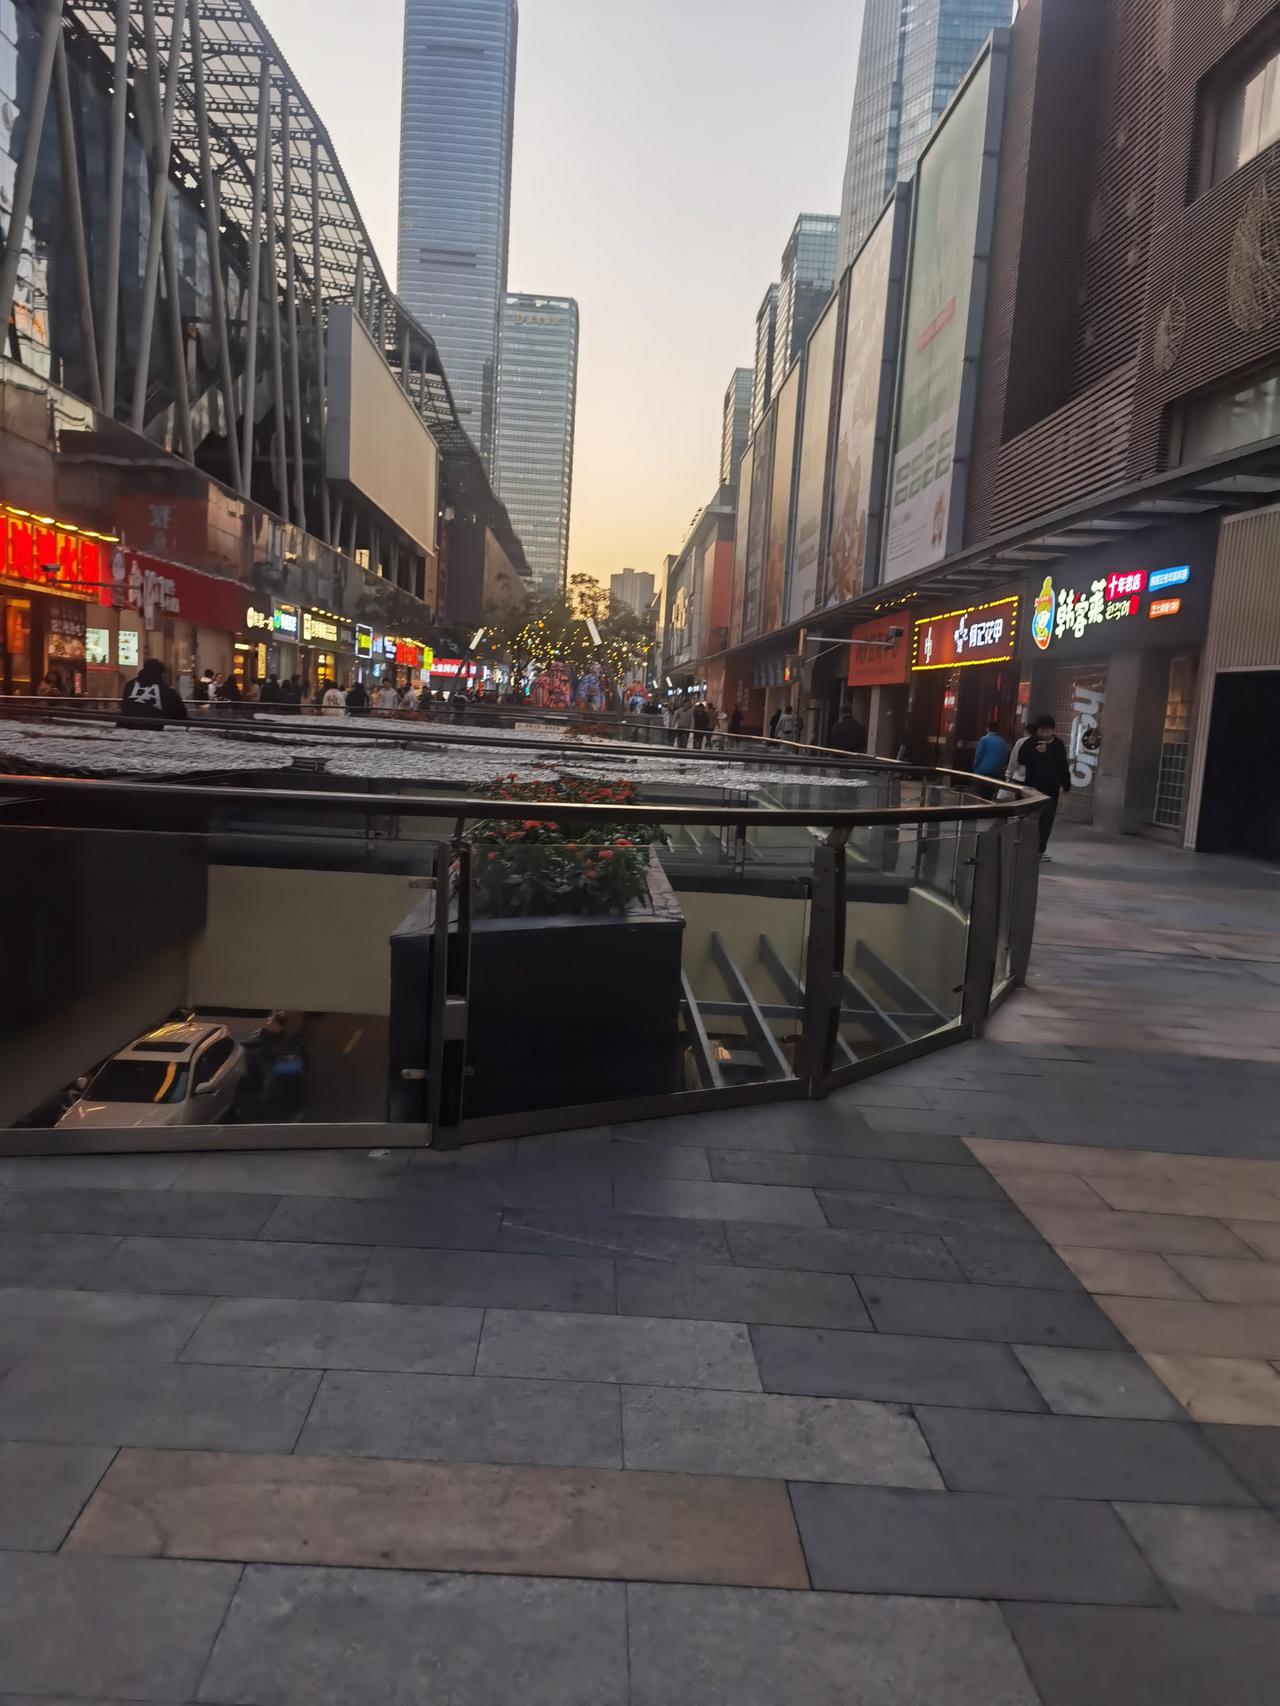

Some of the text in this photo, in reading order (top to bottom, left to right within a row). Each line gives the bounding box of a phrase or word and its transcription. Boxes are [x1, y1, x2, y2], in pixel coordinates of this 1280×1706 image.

[1108, 573, 1142, 599] 十年老店
[128, 681, 163, 710] LA
